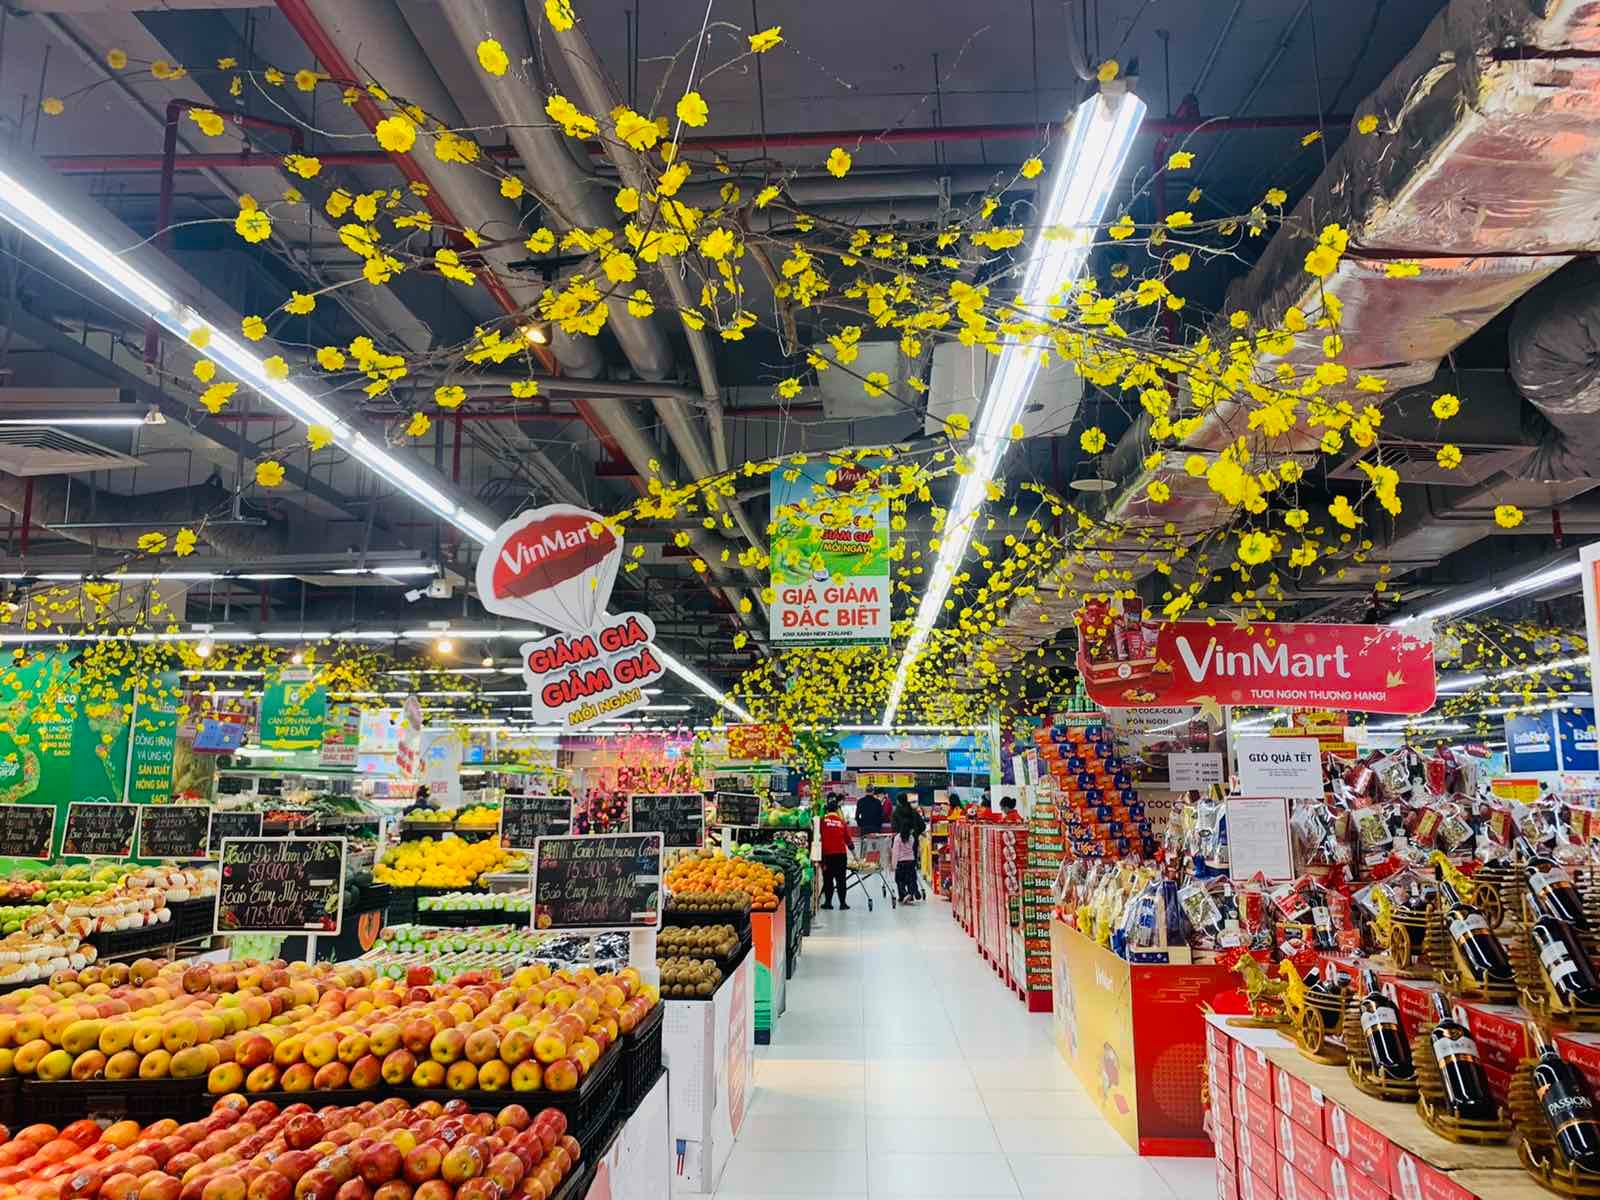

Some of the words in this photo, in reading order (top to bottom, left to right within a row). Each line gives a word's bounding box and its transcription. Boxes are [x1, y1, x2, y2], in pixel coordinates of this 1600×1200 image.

[502, 521, 600, 575] VinMart
[823, 582, 879, 603] GIẢM
[782, 604, 830, 630] ĐẶC
[836, 604, 881, 630] BIỆT
[528, 635, 598, 674] GIẢM
[599, 615, 648, 652] GIÁ
[1175, 635, 1352, 683] VinMart
[541, 667, 613, 708] GIẢM
[613, 648, 662, 684] GIÁ
[568, 701, 599, 726] MỖI
[599, 686, 642, 715] NGÀY!
[1276, 688, 1307, 700] NGON
[1138, 707, 1184, 715] COCA-COLA
[1271, 752, 1293, 764] QUÀ
[1294, 752, 1313, 763] TẾT
[222, 884, 247, 905] Táo
[1547, 1095, 1593, 1117] PASSION
